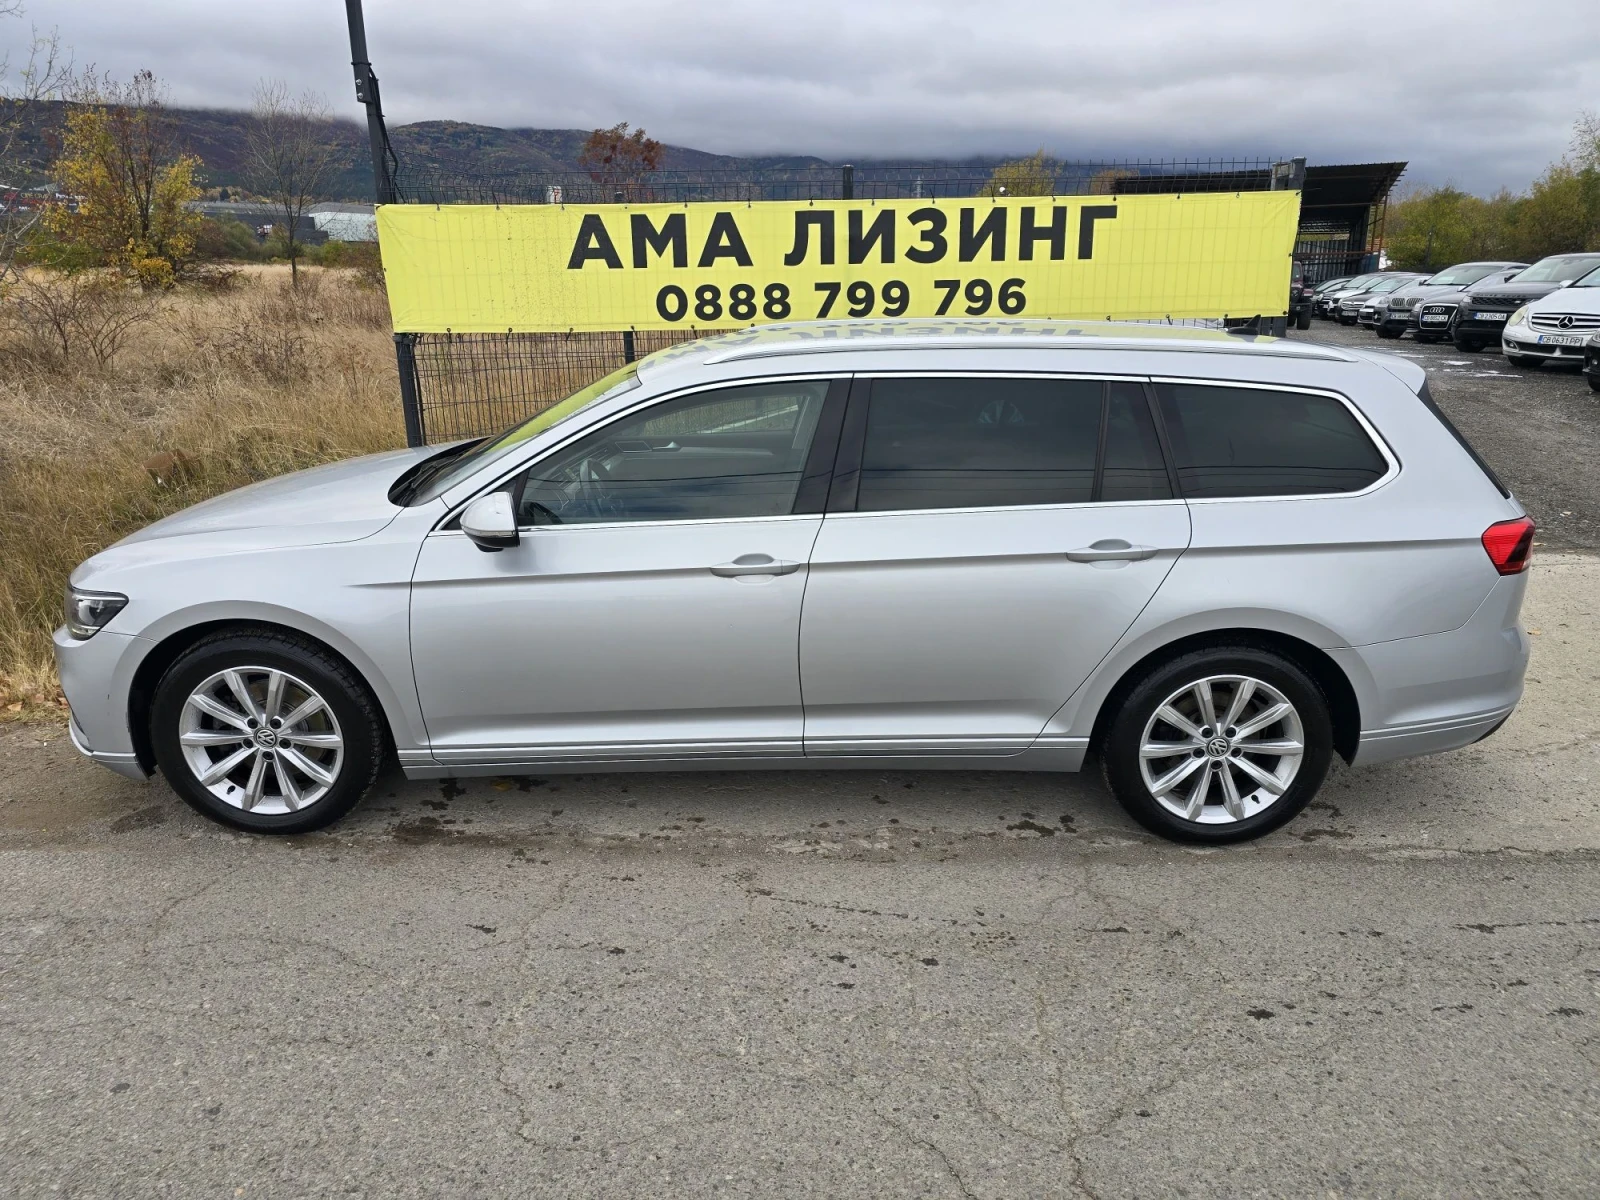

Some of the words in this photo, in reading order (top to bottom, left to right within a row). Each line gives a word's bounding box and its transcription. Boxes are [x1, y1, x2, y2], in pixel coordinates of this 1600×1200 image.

[567, 211, 754, 270] АМА
[783, 204, 1118, 267] ЛИЗИНГ
[656, 282, 792, 322] 0888
[814, 279, 910, 319] 799
[934, 277, 1027, 316] 796
